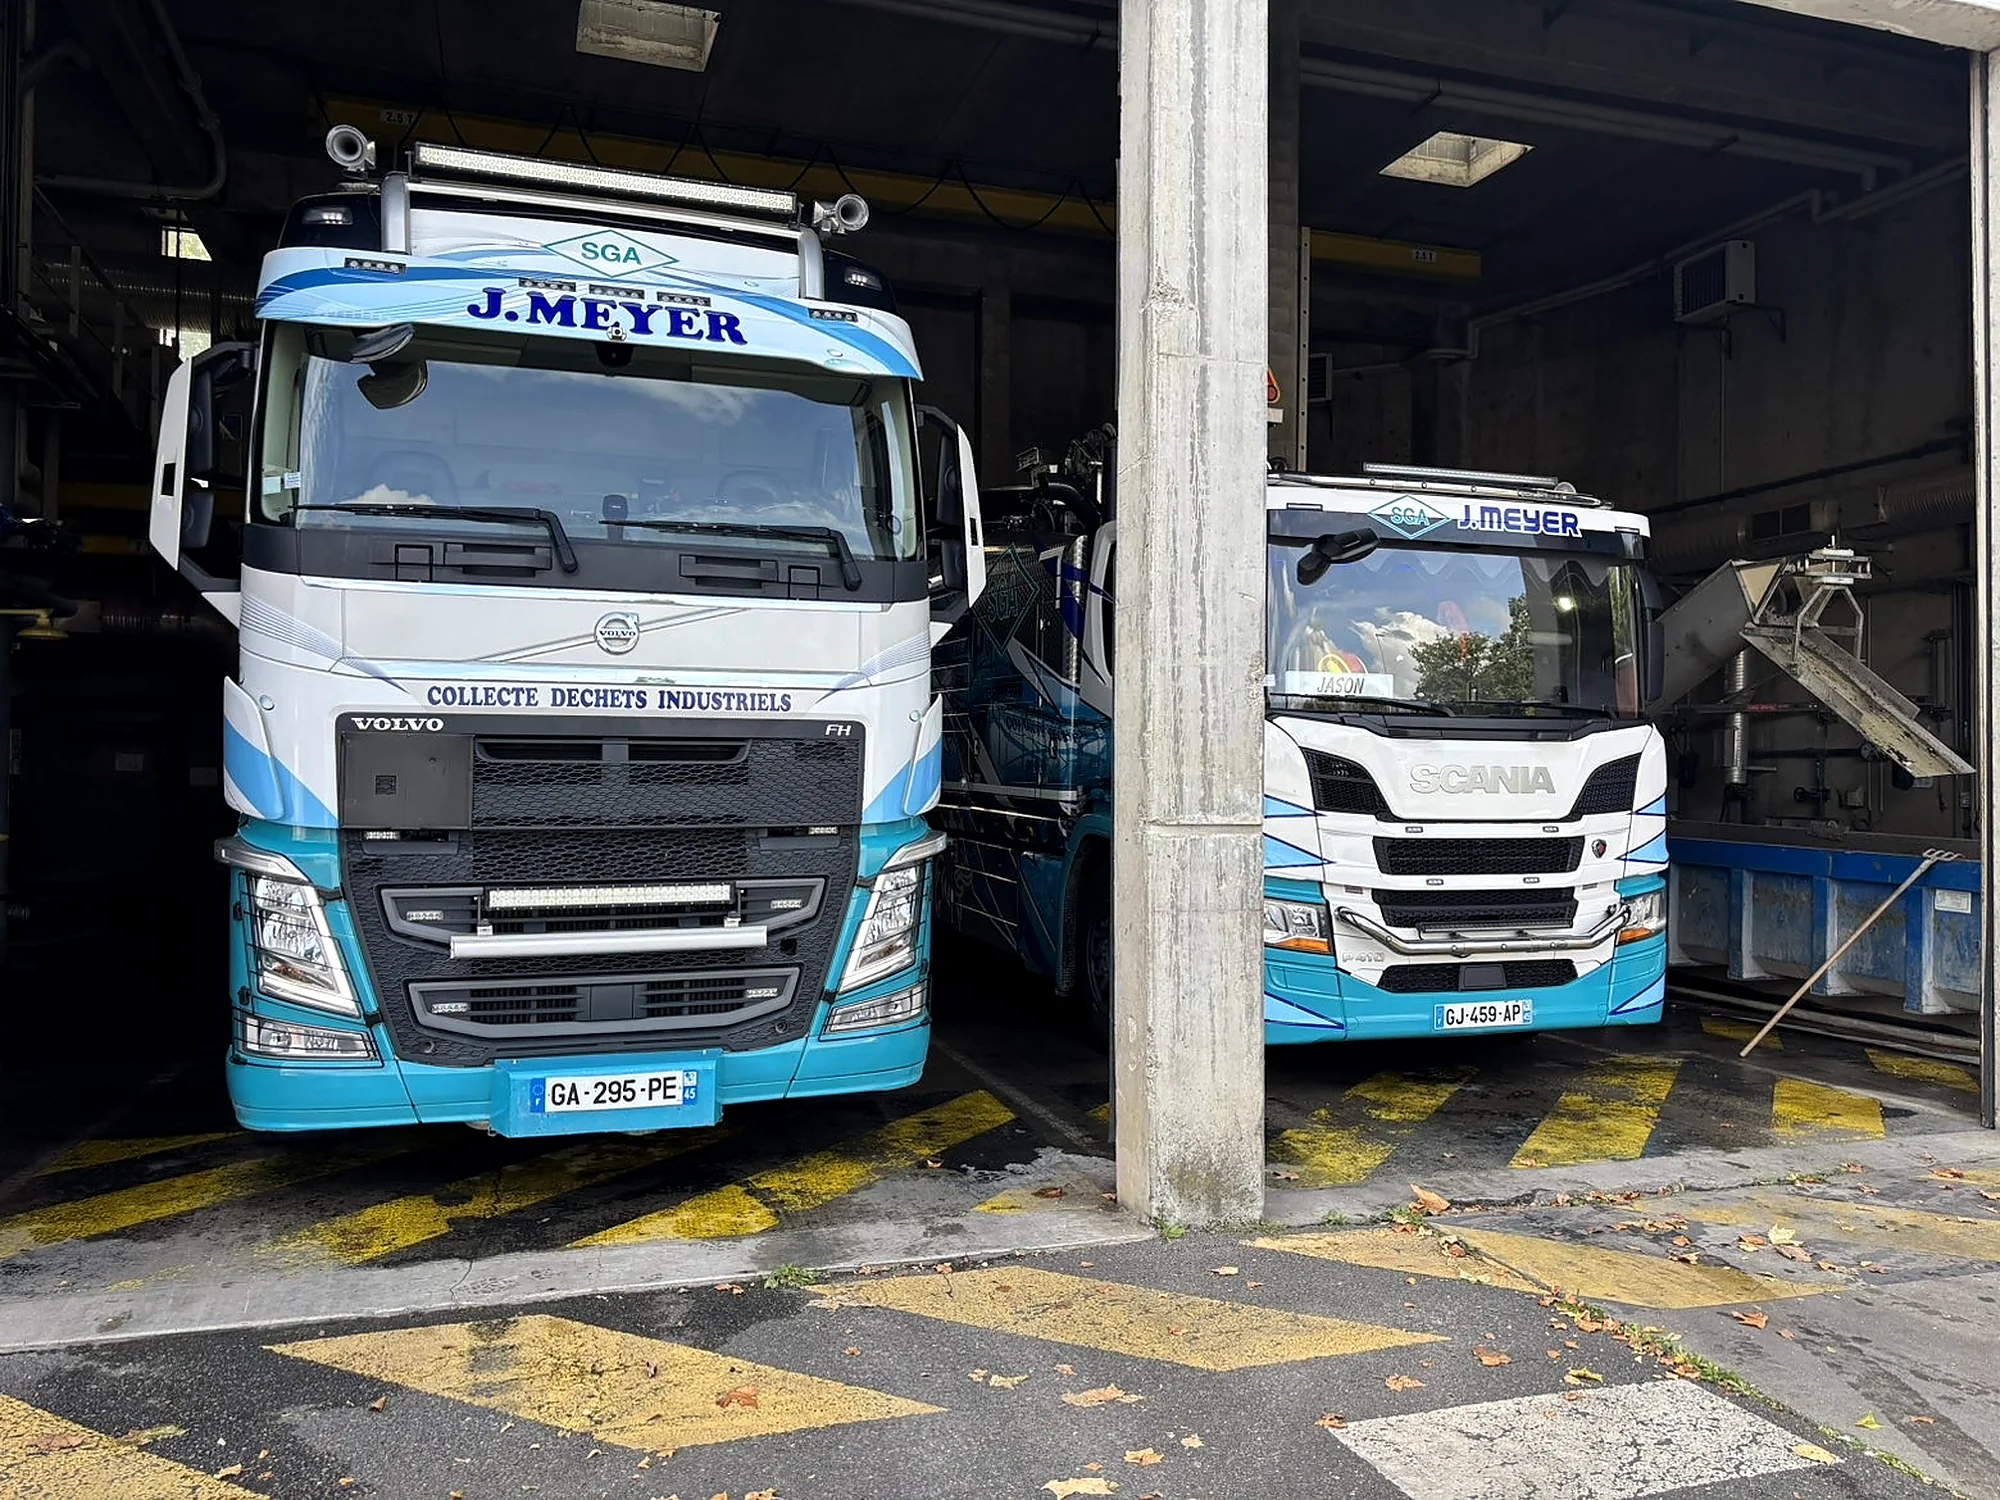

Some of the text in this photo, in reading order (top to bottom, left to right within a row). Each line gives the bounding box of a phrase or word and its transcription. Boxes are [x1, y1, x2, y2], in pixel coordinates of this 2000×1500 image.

[581, 241, 642, 266] SGA
[467, 286, 748, 346] J.MEYER
[1390, 506, 1430, 526] SGA
[1459, 504, 1582, 537] J.MEYER
[1317, 676, 1365, 694] JASON
[427, 685, 792, 712] COLLECTE DECHETS INDUSTRIELS
[351, 717, 444, 731] VOLVO
[825, 723, 852, 736] FH
[1410, 764, 1556, 794] SCANIA
[684, 1088, 696, 1100] 45
